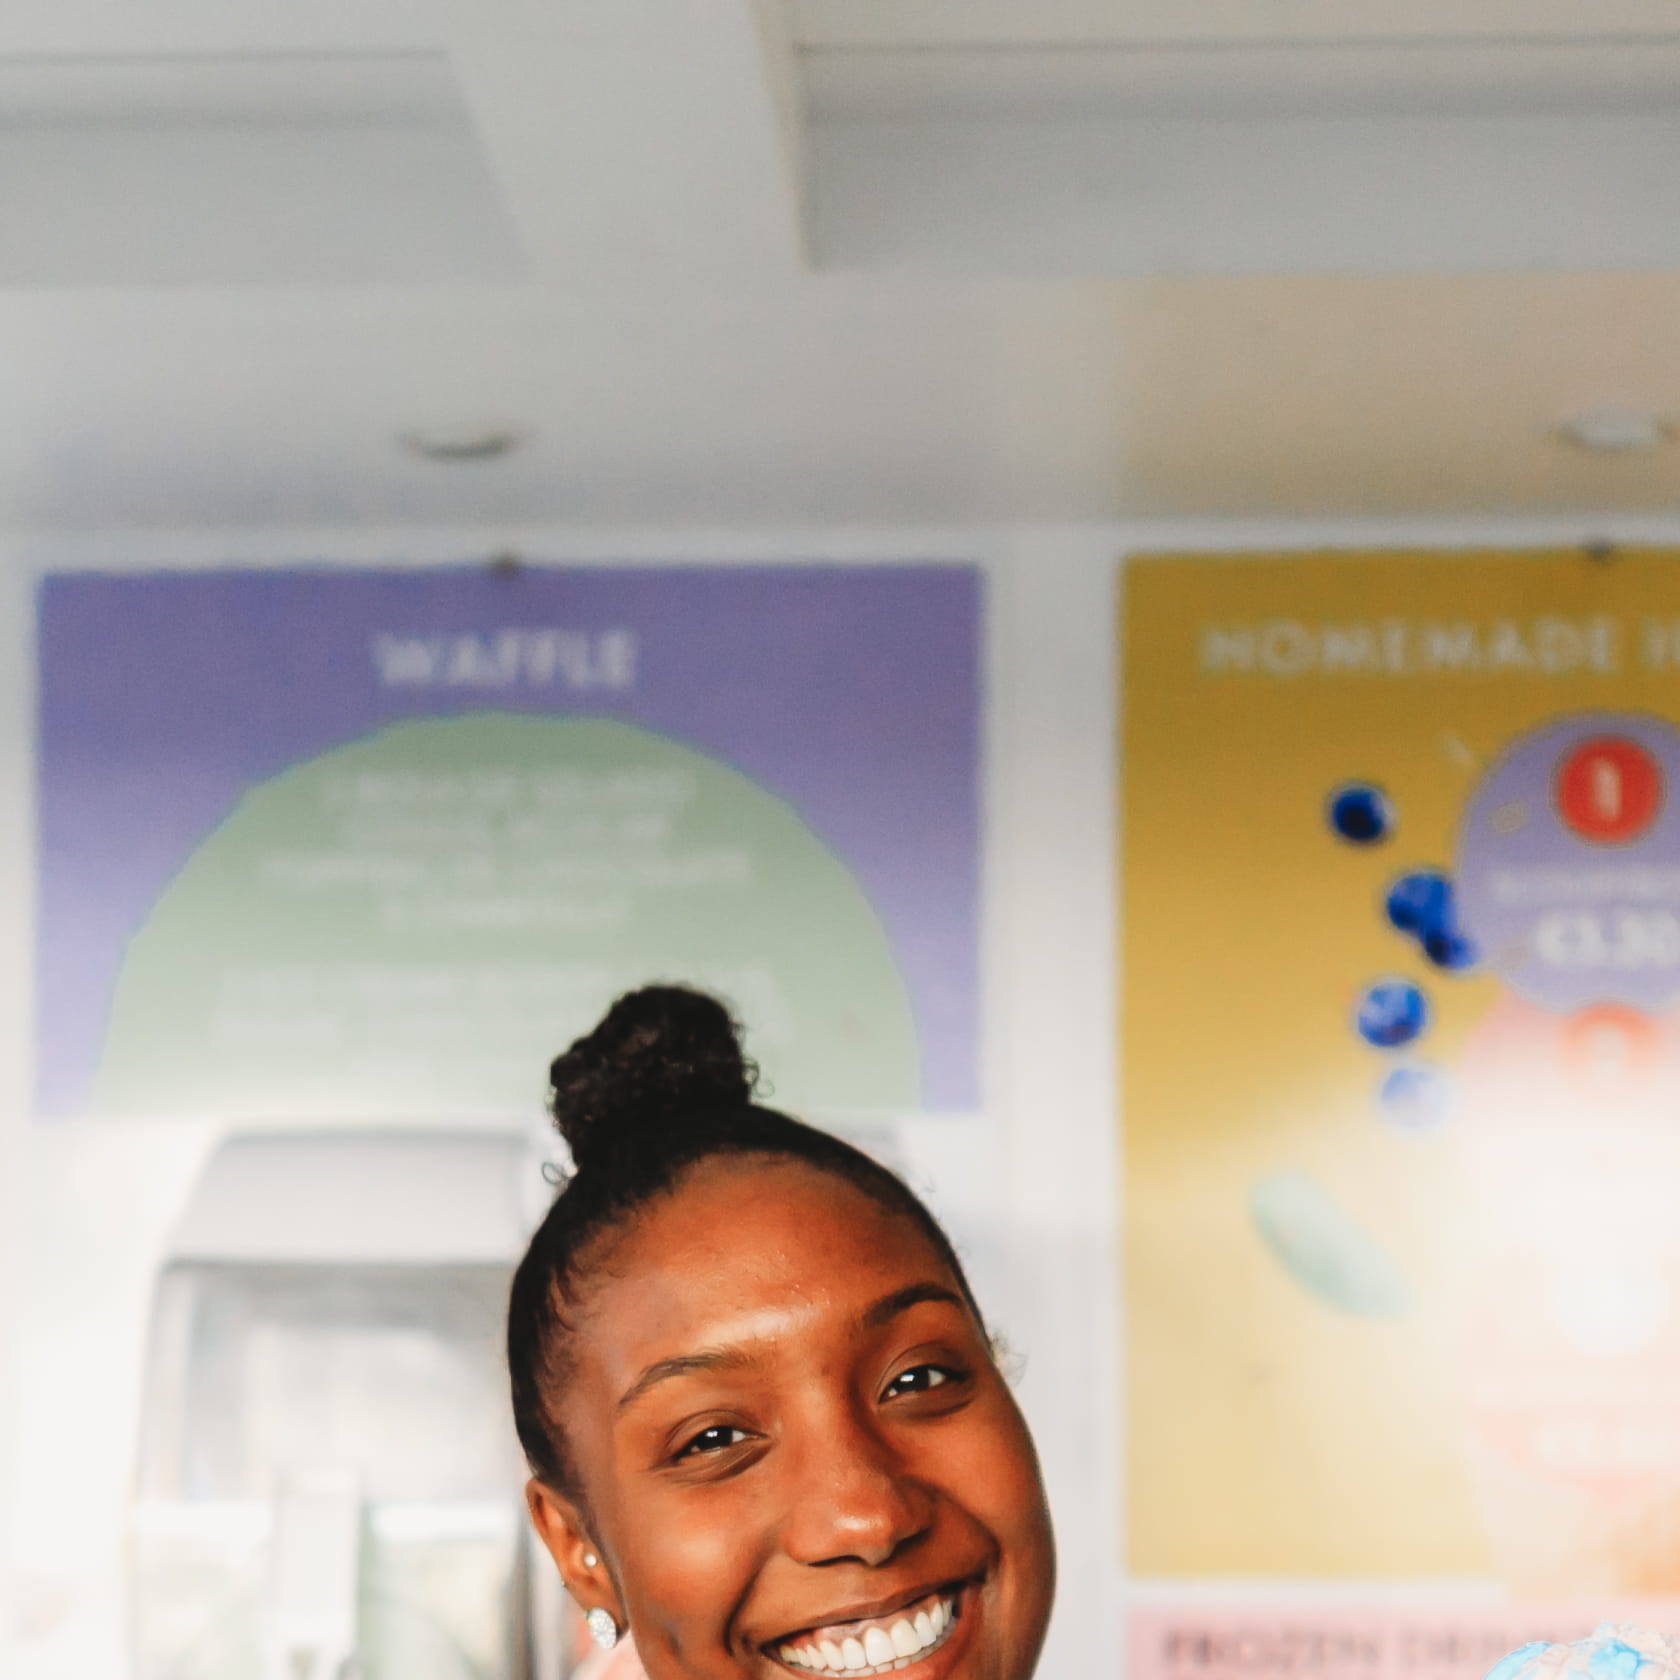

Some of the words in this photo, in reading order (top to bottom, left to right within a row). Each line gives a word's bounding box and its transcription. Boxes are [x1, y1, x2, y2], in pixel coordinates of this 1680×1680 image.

[370, 629, 639, 687] WAFFLE
[1199, 615, 1618, 677] HOMEMADE
[1592, 758, 1621, 819] 1
[1164, 1626, 1380, 1671] FROZEN
